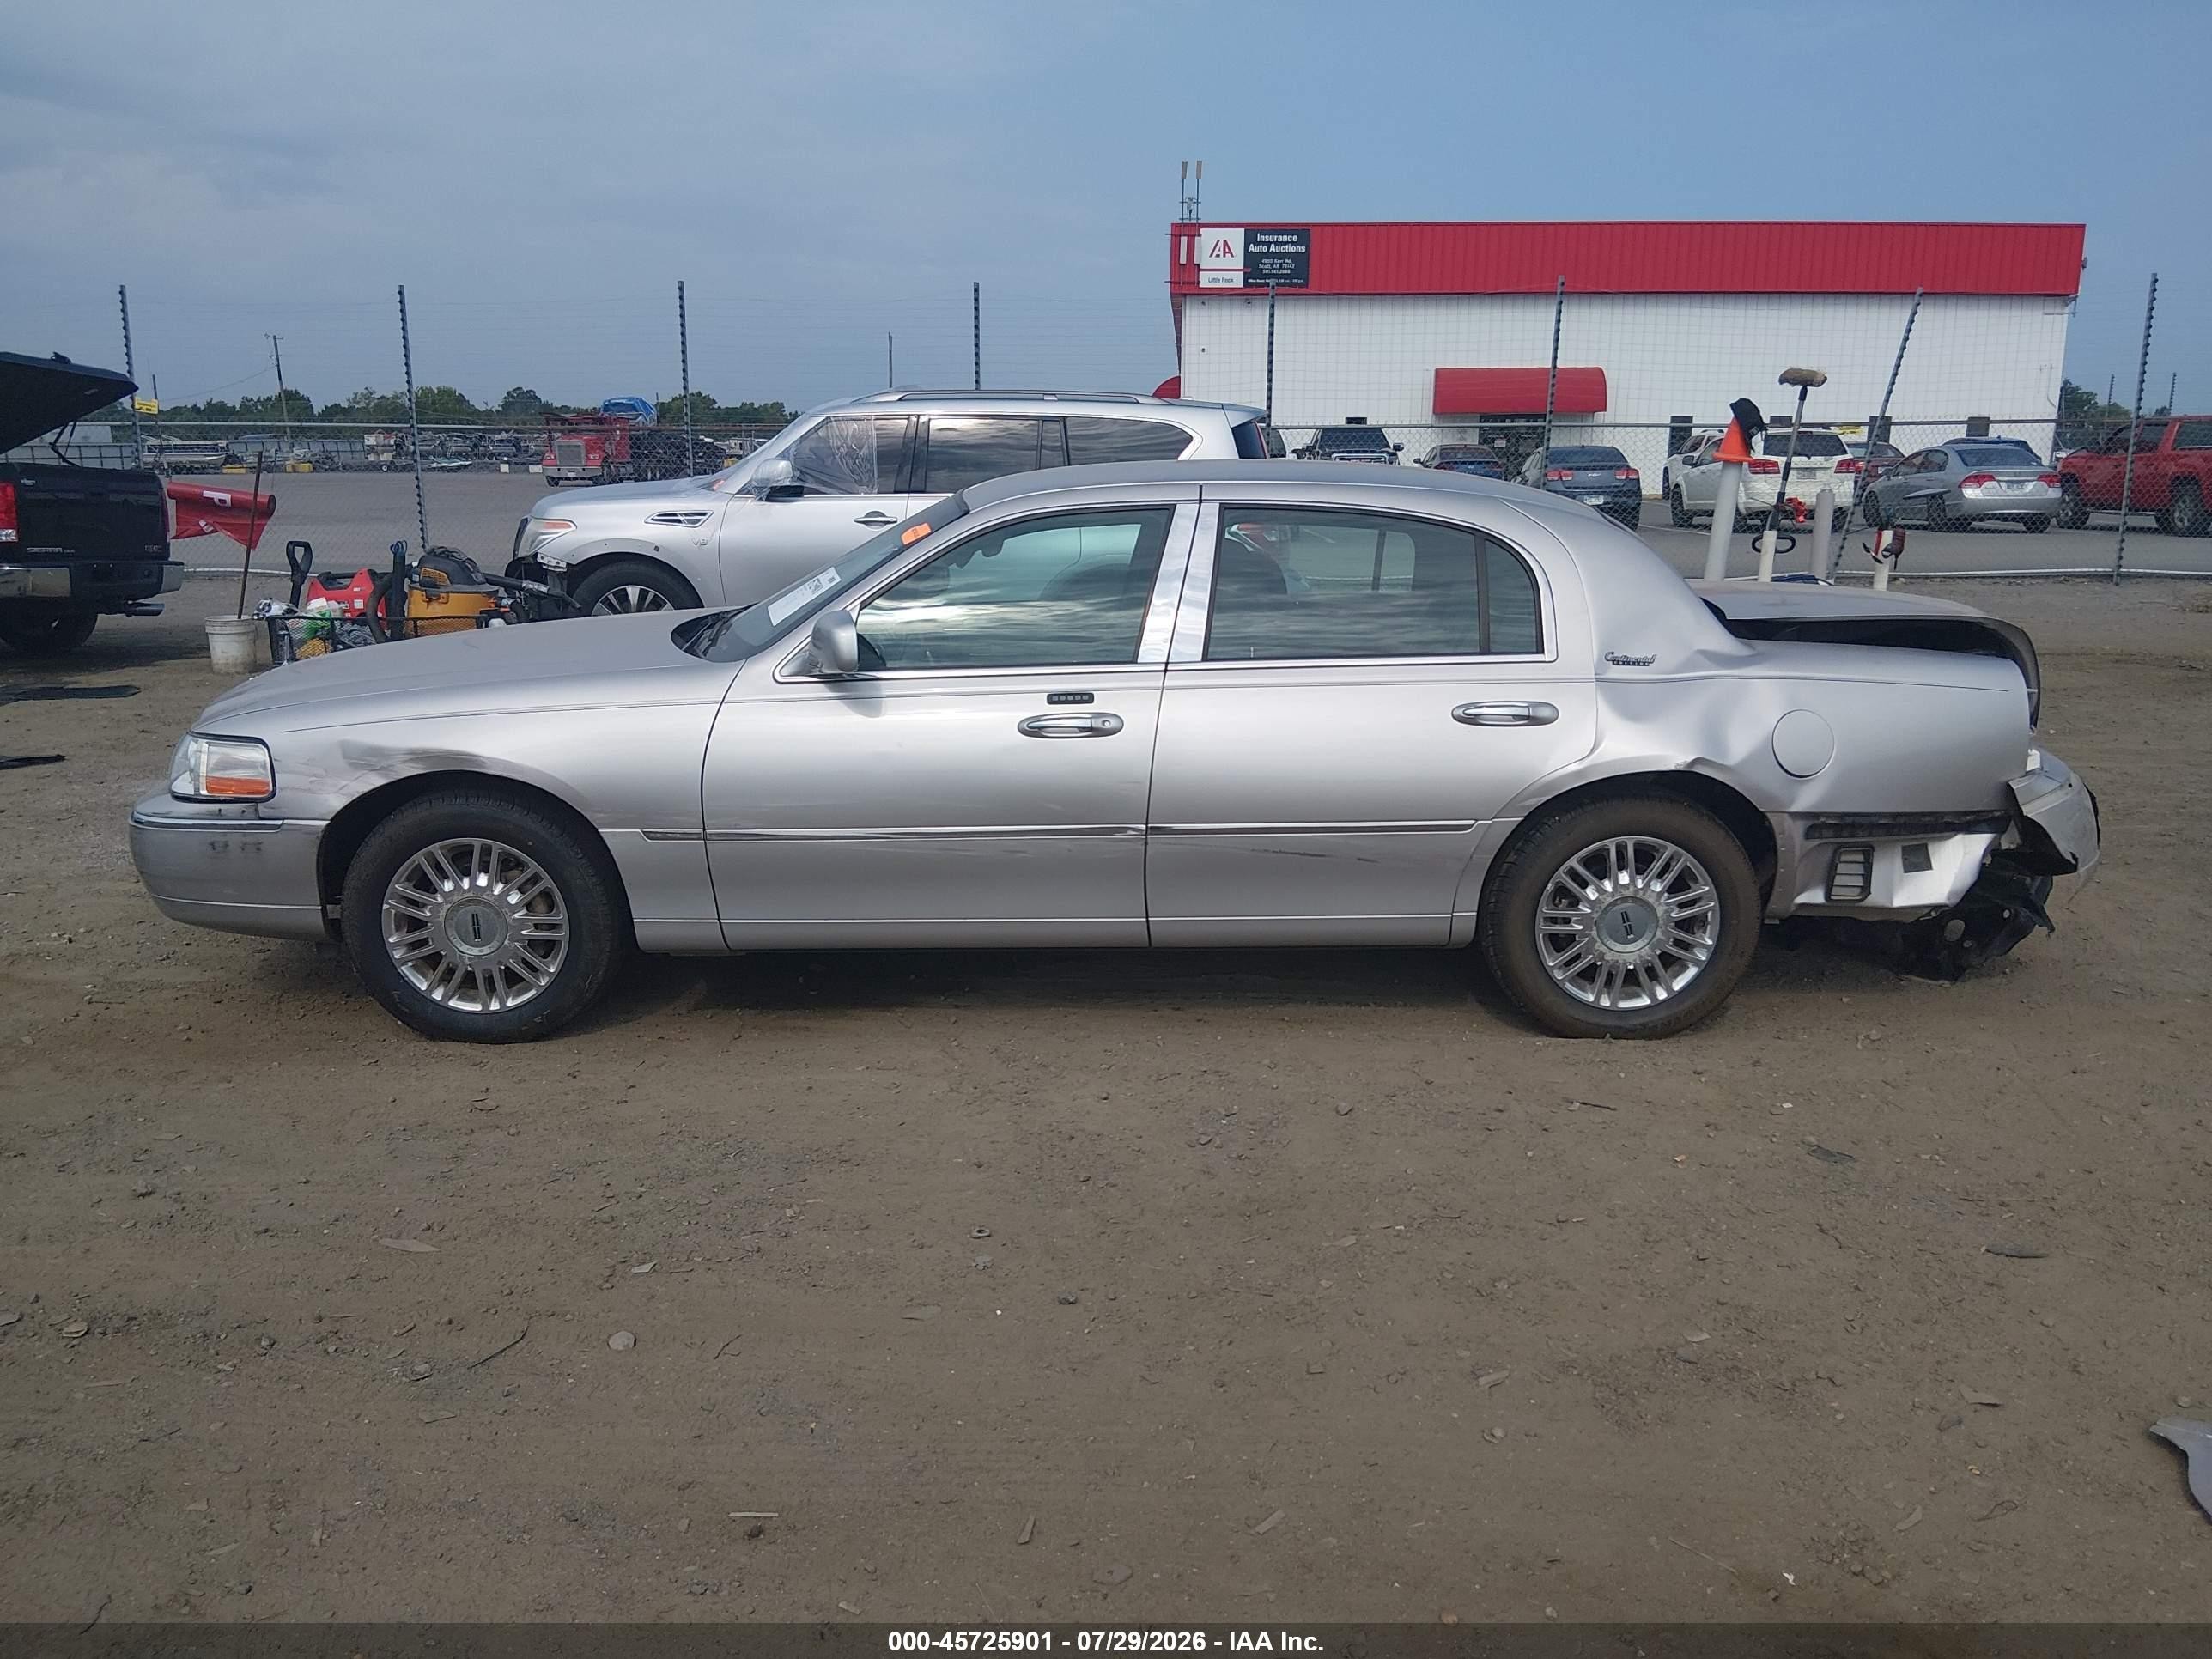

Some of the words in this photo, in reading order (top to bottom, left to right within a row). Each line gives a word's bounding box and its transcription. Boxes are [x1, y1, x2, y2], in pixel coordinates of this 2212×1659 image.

[1256, 233, 1298, 242] Insurance
[1248, 243, 1267, 252] Auto
[1269, 243, 1306, 252] Auctions
